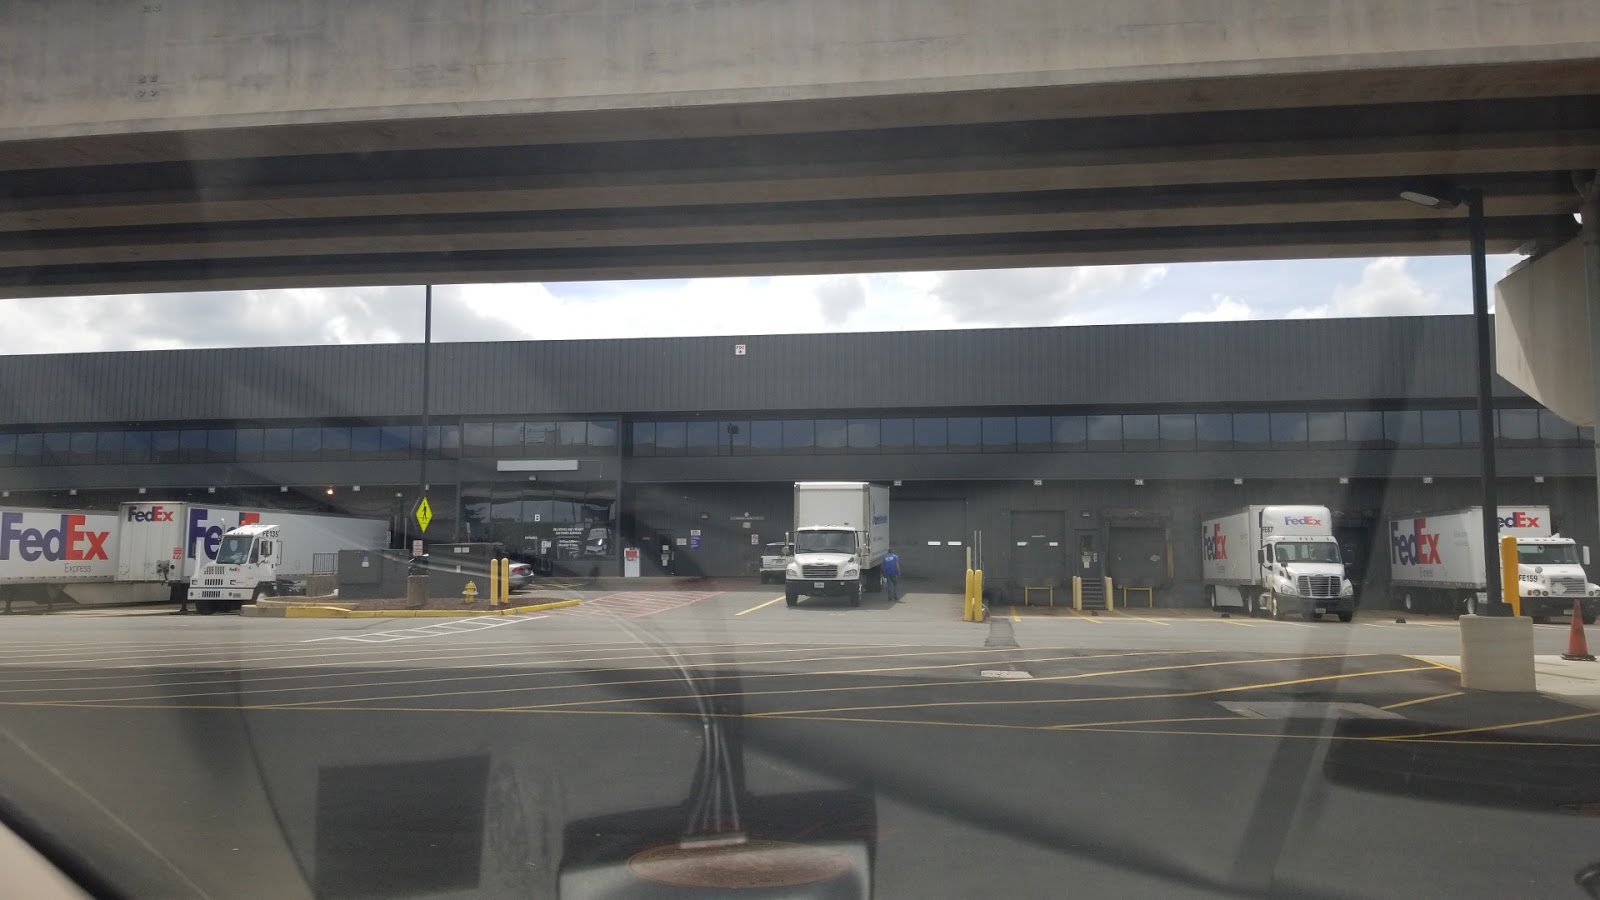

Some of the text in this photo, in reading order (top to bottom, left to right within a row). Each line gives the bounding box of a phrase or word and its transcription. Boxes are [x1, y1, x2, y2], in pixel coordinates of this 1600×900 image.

[128, 506, 174, 522] FedEx
[534, 514, 541, 522] B
[1284, 515, 1322, 526] FedEx
[1497, 511, 1540, 528] edEx
[0, 511, 110, 562] FedEx
[1203, 522, 1228, 562] FedEx
[1391, 517, 1442, 566] FedEx
[64, 563, 92, 574] Express
[1518, 574, 1538, 583] FE159
